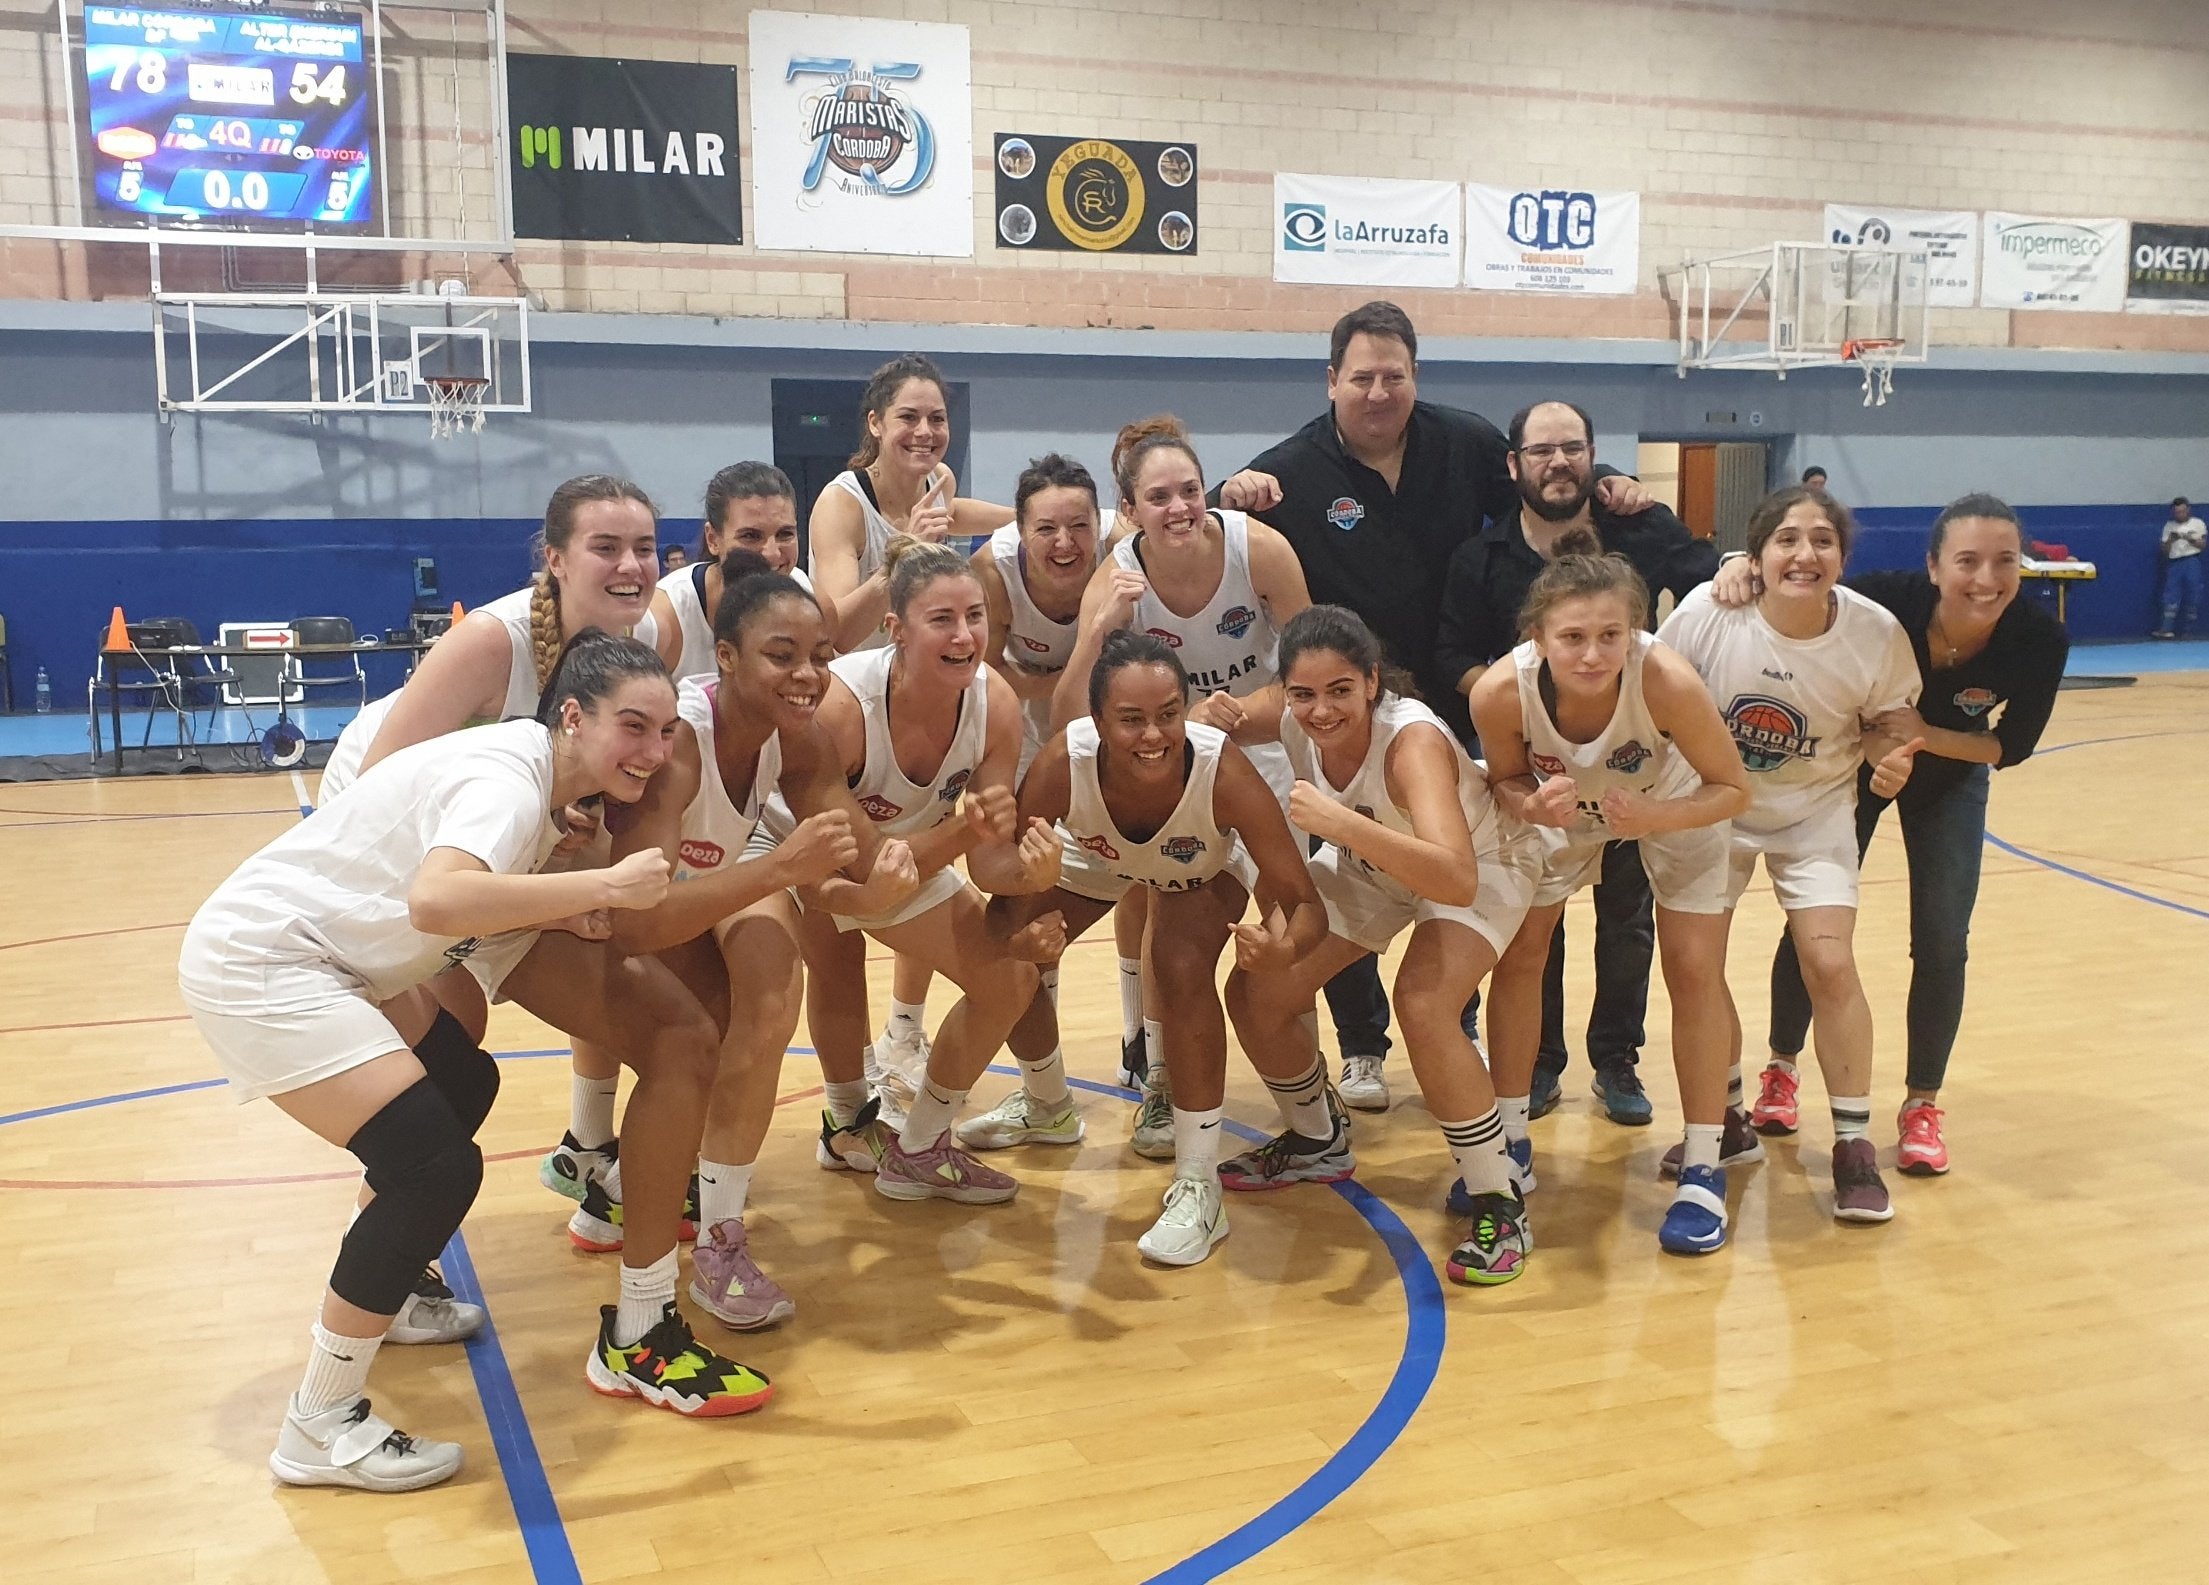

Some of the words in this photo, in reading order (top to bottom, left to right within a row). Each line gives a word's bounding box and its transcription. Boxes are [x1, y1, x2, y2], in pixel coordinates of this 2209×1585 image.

[107, 48, 167, 94] 78
[289, 62, 346, 106] 54
[208, 120, 252, 149] 4Q
[812, 95, 912, 141] MARISTAS
[313, 147, 365, 161] TOYOTA
[572, 126, 725, 176] MILAR
[833, 133, 891, 159] CORDOBA
[1051, 143, 1137, 183] YEGUADA
[203, 170, 269, 210] 0.0
[1334, 219, 1449, 245] laArruzafa
[1513, 196, 1592, 246] OTC
[2000, 233, 2101, 260] impermeco
[389, 370, 409, 397] P2
[1187, 654, 1258, 687] MILAR
[1726, 718, 1812, 755] ORDOBA
